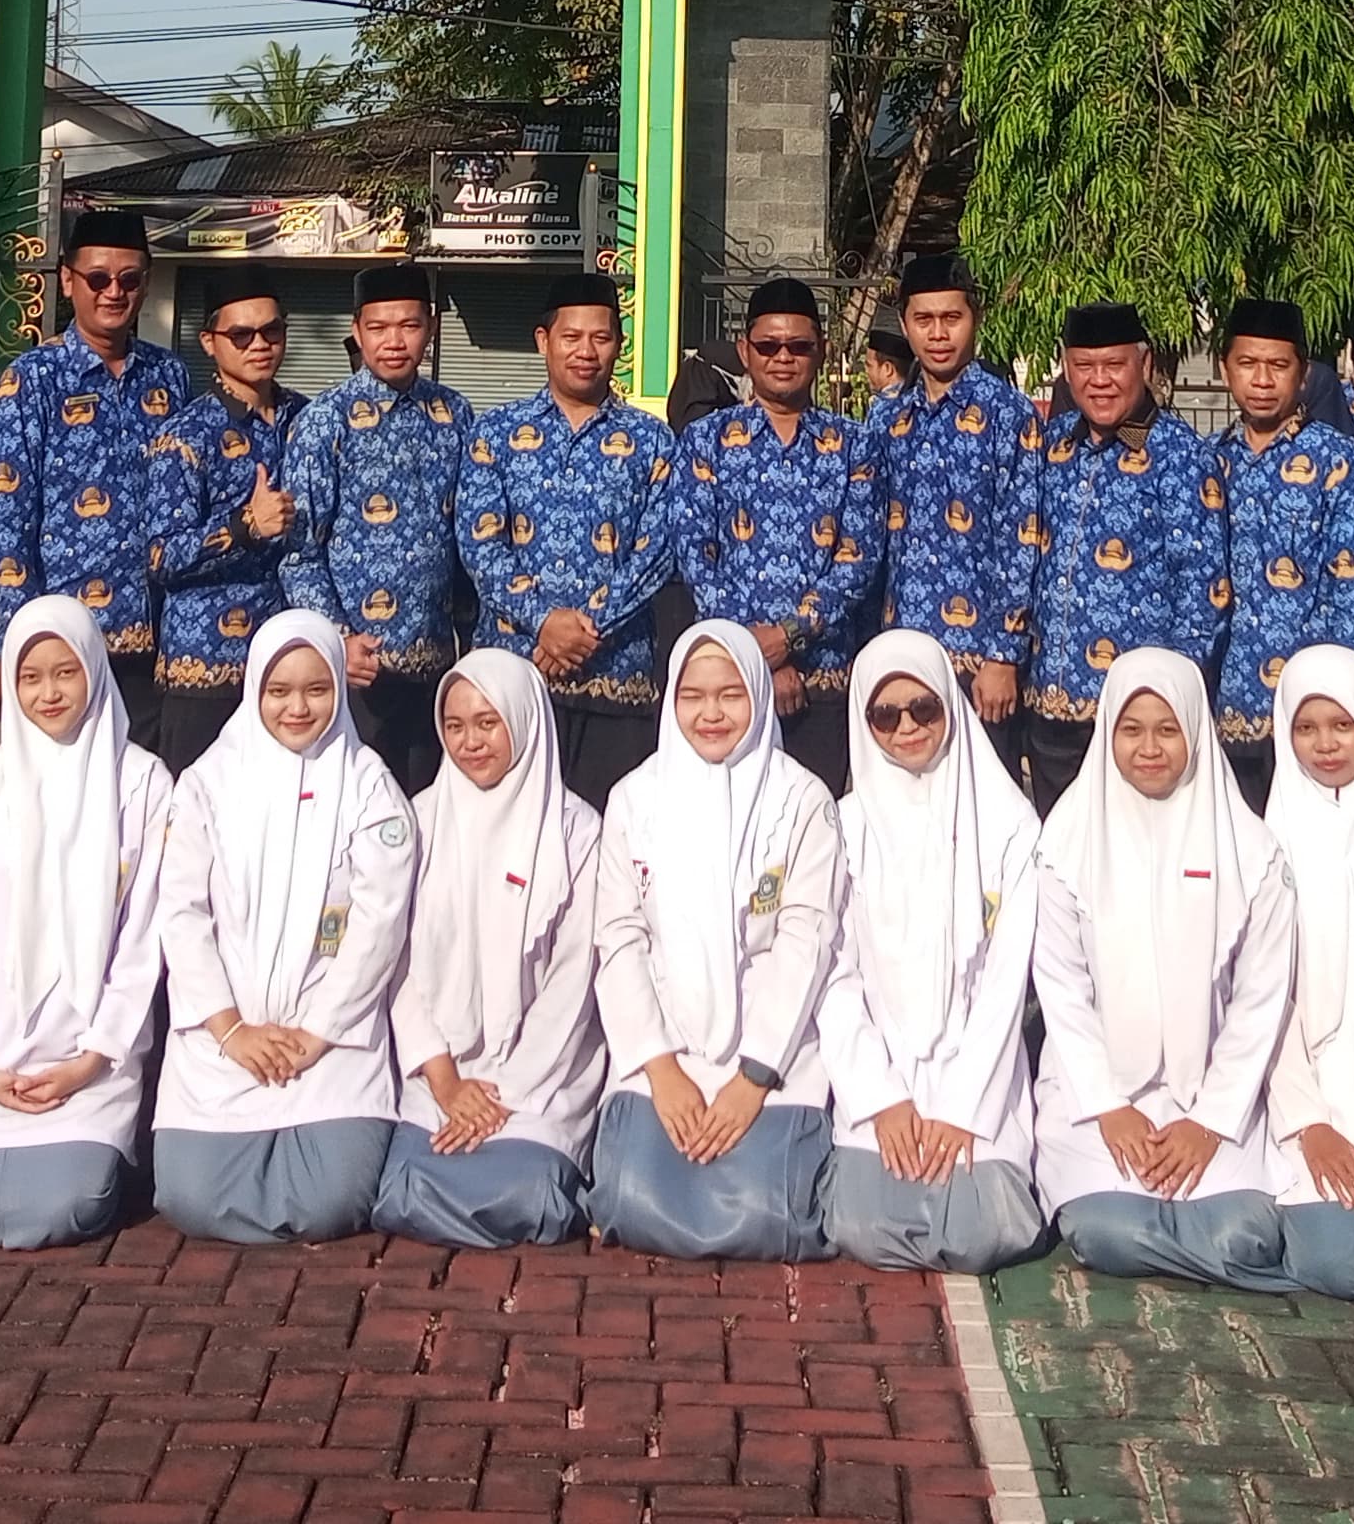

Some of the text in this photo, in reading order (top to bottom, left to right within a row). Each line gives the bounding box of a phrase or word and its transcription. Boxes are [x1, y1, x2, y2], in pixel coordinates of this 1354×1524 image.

[454, 183, 559, 205] Alkaline
[496, 213, 529, 223] Luar
[484, 234, 536, 246] PHOTO
[544, 234, 582, 246] COPY
